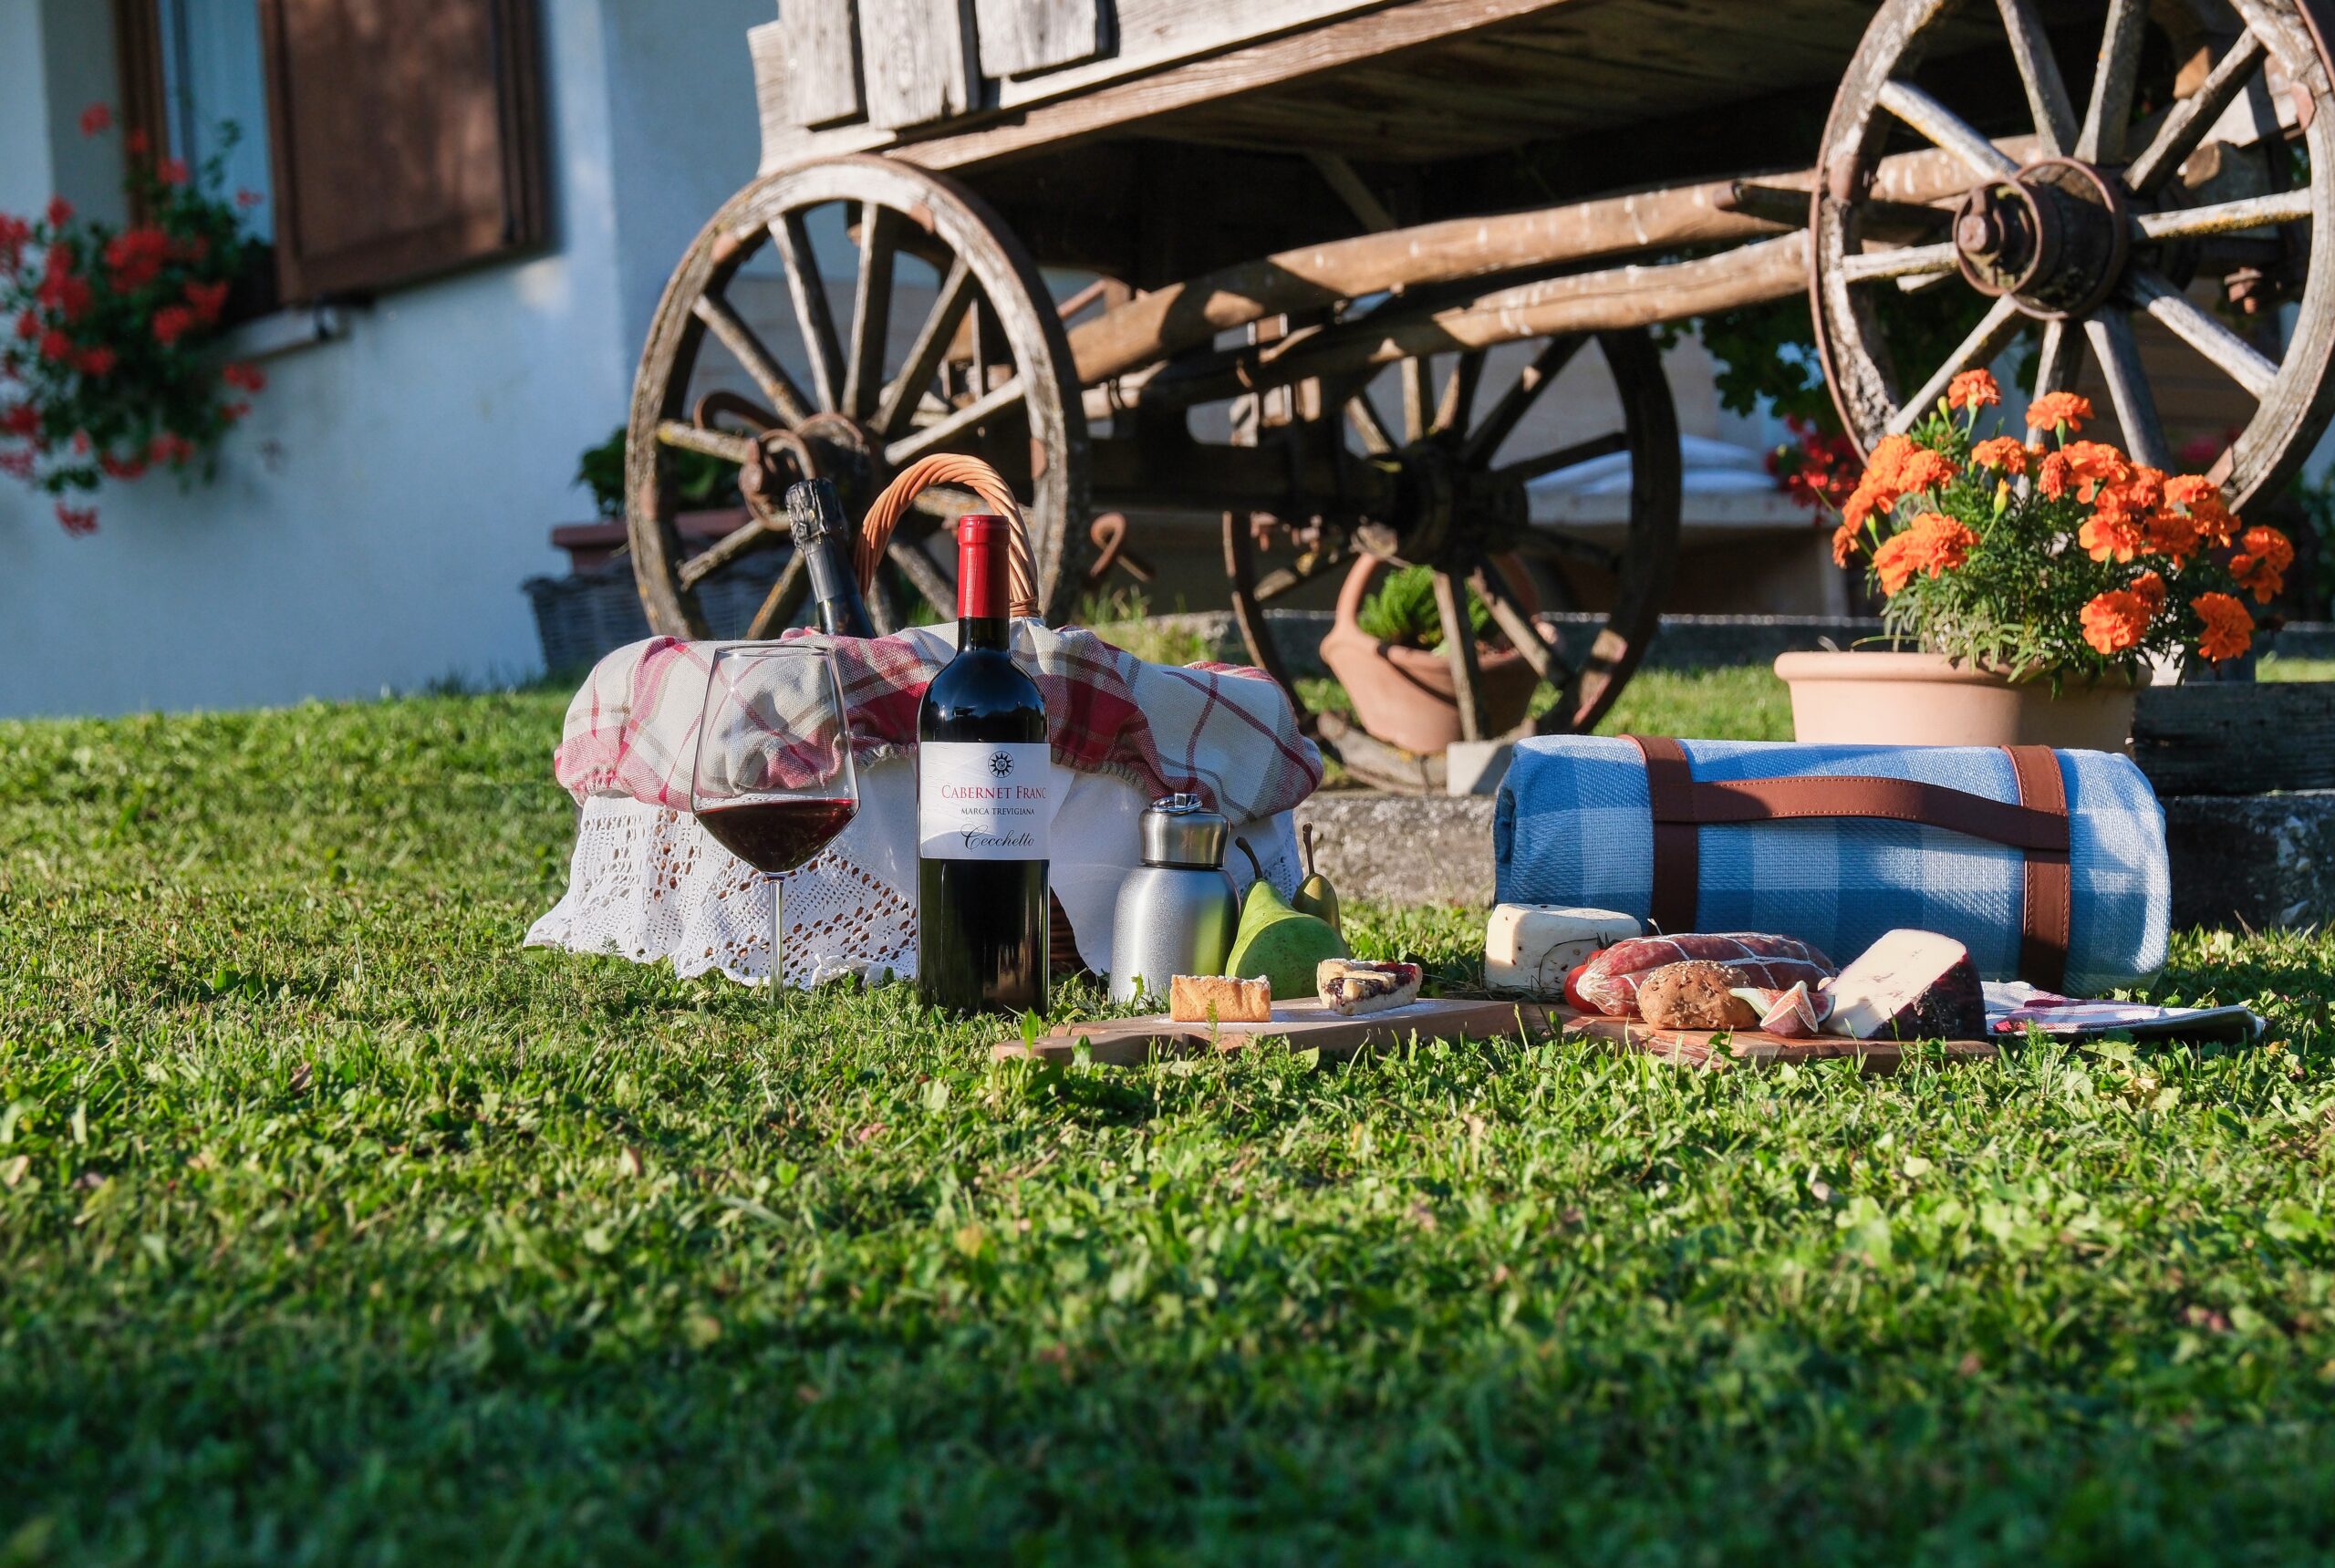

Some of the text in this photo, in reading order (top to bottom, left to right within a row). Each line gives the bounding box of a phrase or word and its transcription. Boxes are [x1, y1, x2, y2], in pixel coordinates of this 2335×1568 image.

[941, 784, 1046, 799] CABERNET FRANC
[960, 807, 1035, 815] MARCA TREVIGIANA
[960, 823, 1034, 852] Cecchetto
